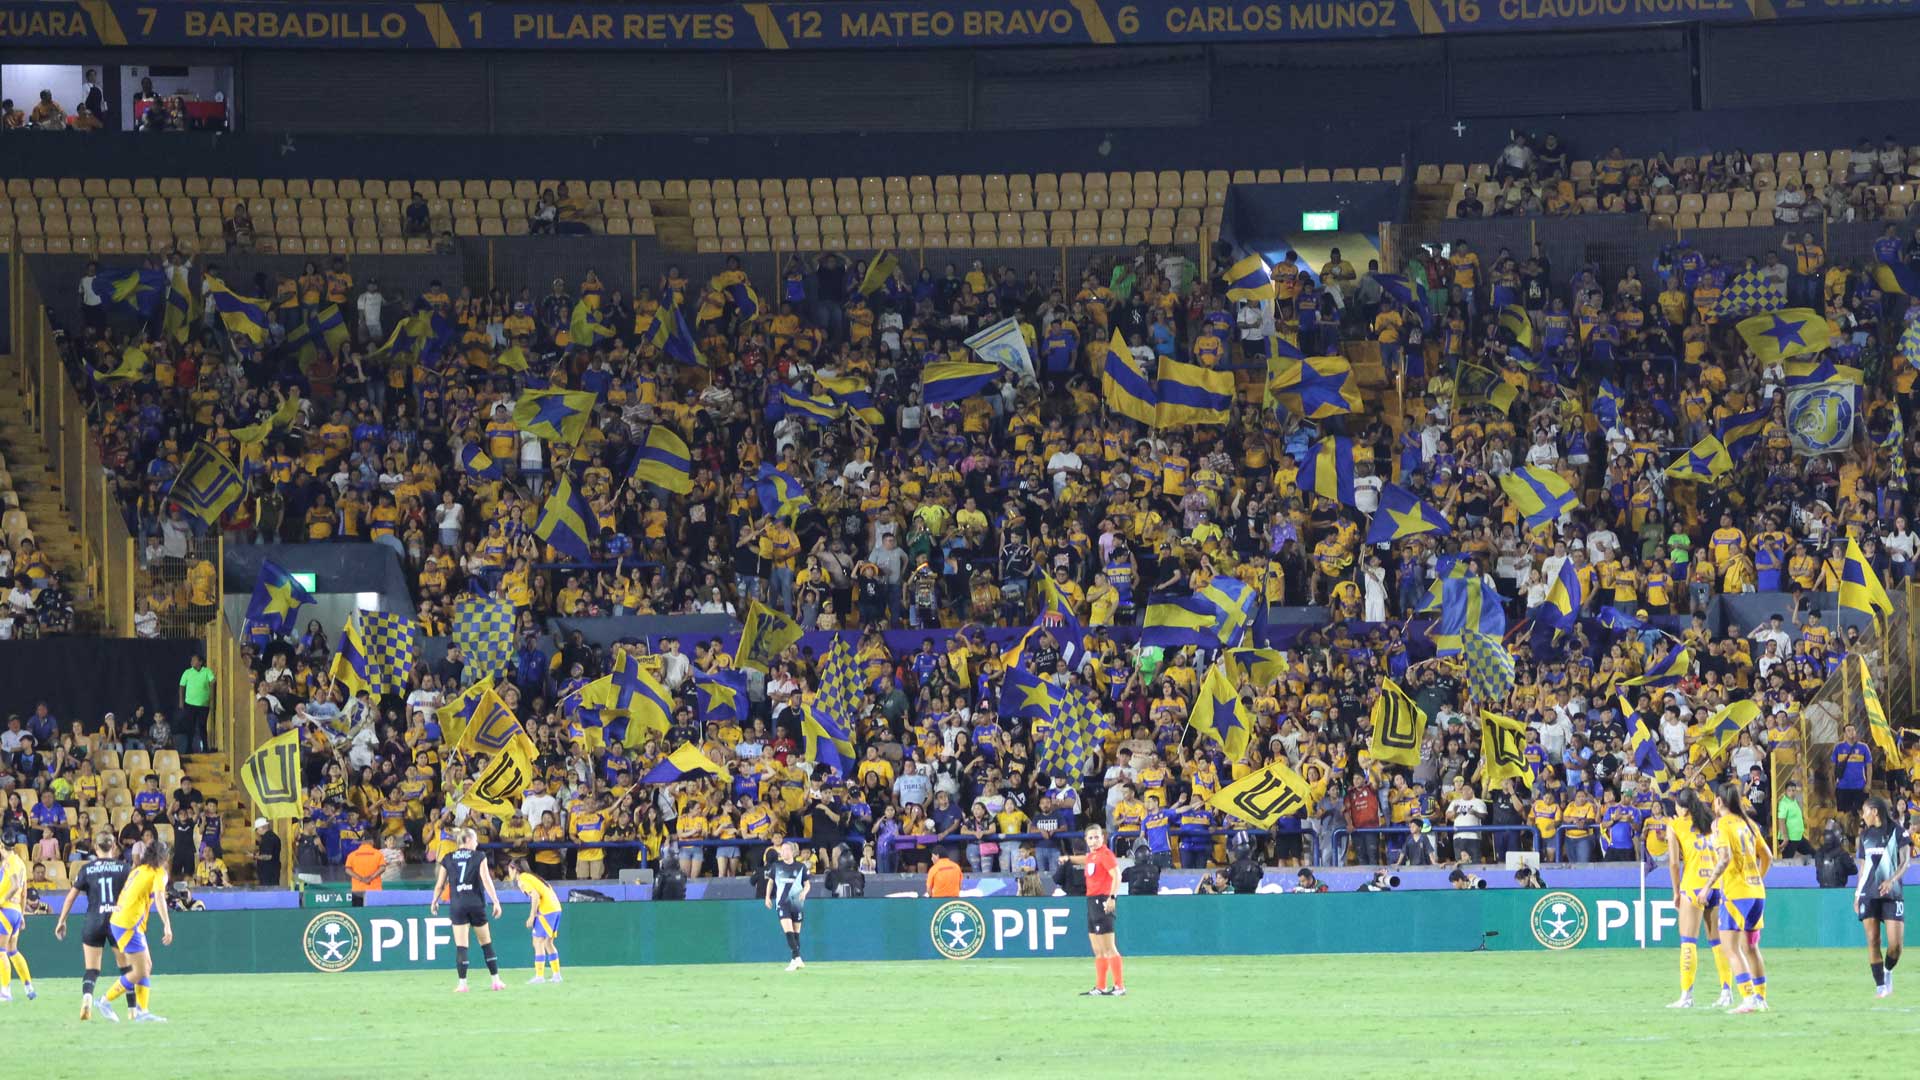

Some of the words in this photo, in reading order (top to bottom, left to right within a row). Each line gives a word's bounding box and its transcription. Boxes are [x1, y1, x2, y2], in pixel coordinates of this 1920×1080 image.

[137, 9, 157, 36] 7
[185, 12, 407, 38] BARBADILLO
[469, 12, 483, 39] 1
[513, 14, 613, 39] PILAR
[623, 14, 734, 39] REYES
[787, 12, 822, 38] 12
[840, 11, 954, 38] MATEO
[963, 8, 1073, 35] BRAVO
[1118, 6, 1140, 34] 6
[1166, 4, 1282, 33] CARLOS
[1446, 0, 1480, 23] 16
[98, 877, 114, 903] 11
[457, 861, 467, 883] 7
[315, 893, 343, 903] RUA
[370, 917, 453, 962] PIF
[992, 908, 1070, 951] PIF
[1596, 900, 1678, 941] PIF
